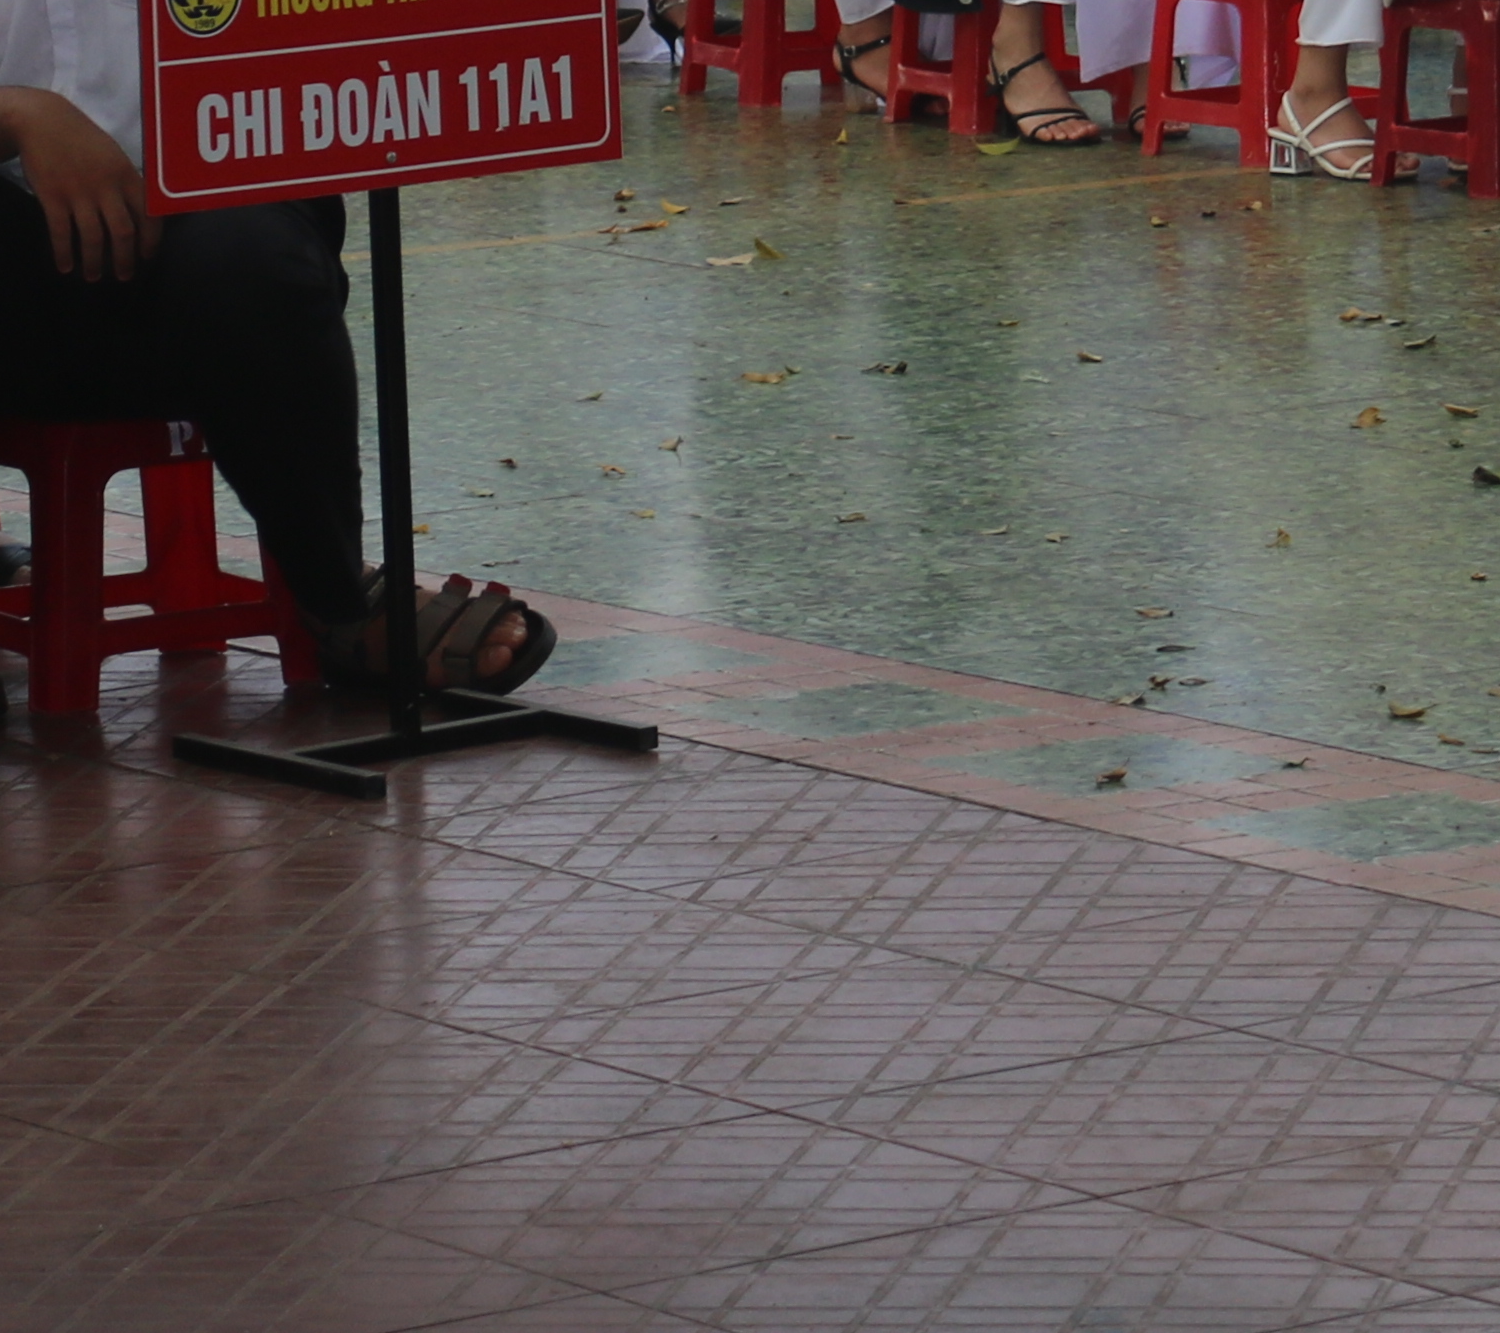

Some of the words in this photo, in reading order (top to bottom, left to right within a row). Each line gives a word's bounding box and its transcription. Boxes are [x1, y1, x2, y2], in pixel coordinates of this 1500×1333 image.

[197, 87, 284, 163] CHI
[299, 60, 442, 151] ĐOÀN
[459, 55, 573, 132] 11A1
